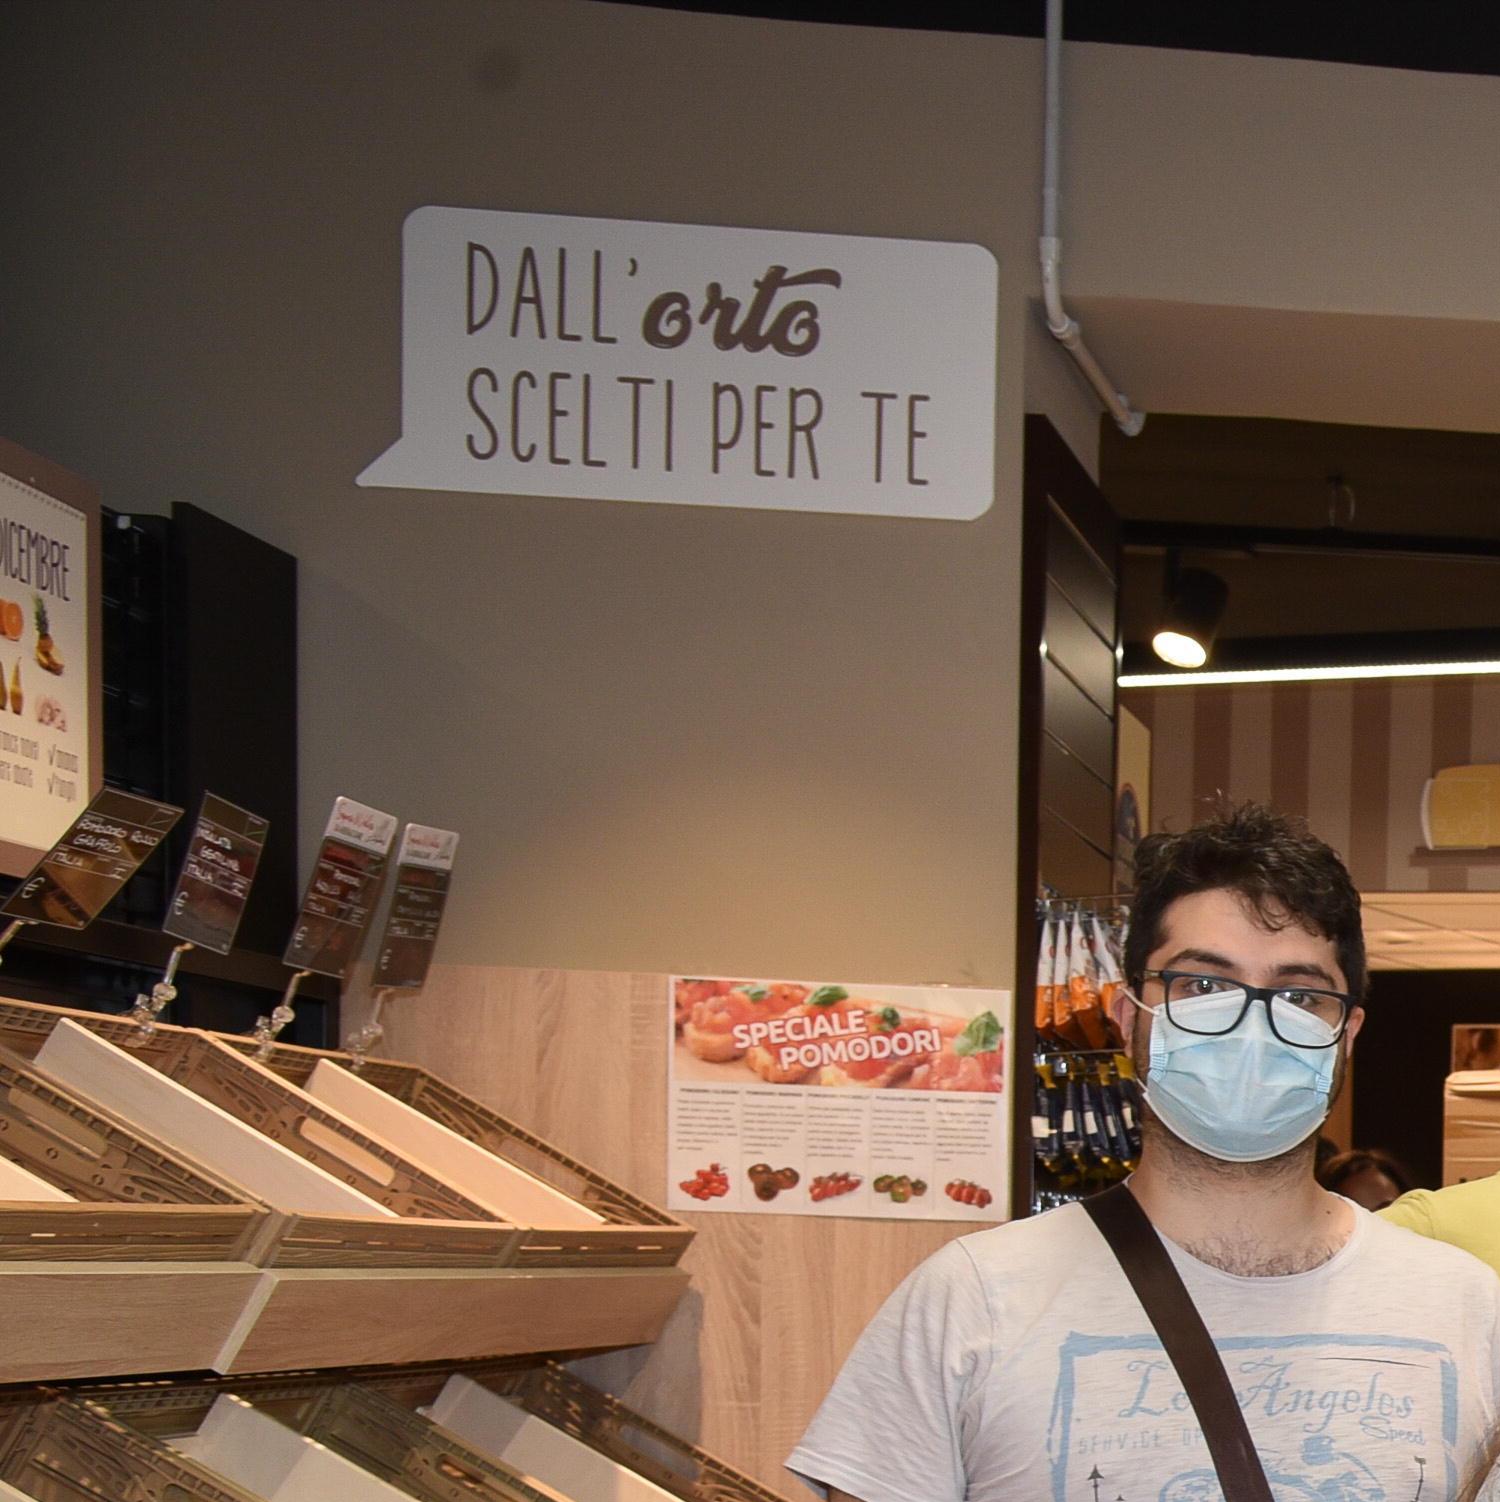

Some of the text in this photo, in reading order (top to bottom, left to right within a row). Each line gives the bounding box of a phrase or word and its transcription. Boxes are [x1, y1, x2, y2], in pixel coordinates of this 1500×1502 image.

[464, 366, 931, 486] SCELTI PER TE
[732, 1009, 868, 1050] SPECIALE
[779, 1028, 942, 1071] POMODORI
[1238, 1355, 1415, 1434] Angeles
[1358, 1414, 1426, 1447] Speed
